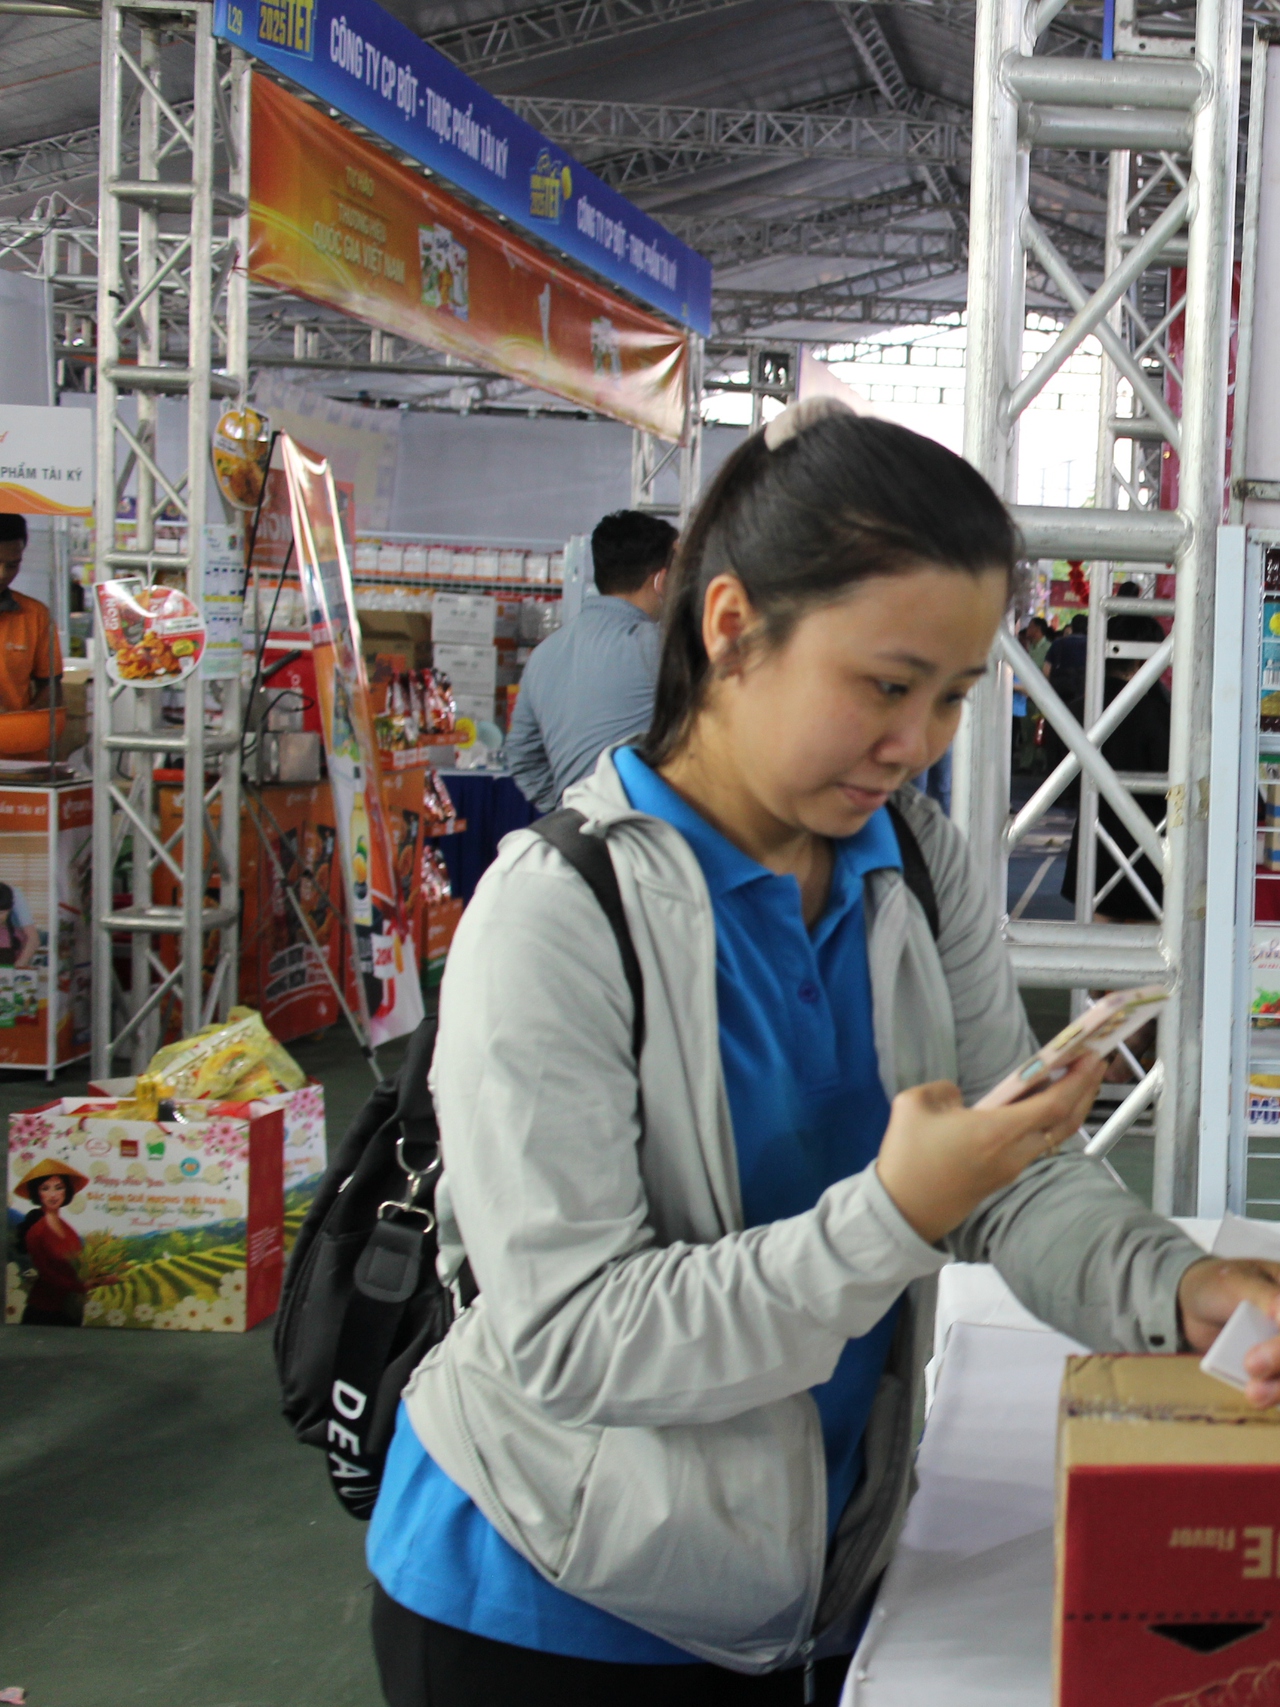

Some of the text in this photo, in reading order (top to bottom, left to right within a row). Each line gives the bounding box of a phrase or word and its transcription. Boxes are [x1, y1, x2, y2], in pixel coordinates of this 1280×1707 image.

[259, 5, 287, 45] 2025
[329, 15, 363, 79] CÔNG
[364, 42, 380, 91] TY
[381, 55, 397, 100] CP
[397, 65, 418, 121] BỘT
[0, 462, 83, 482] PHẨM TÀI KÝ
